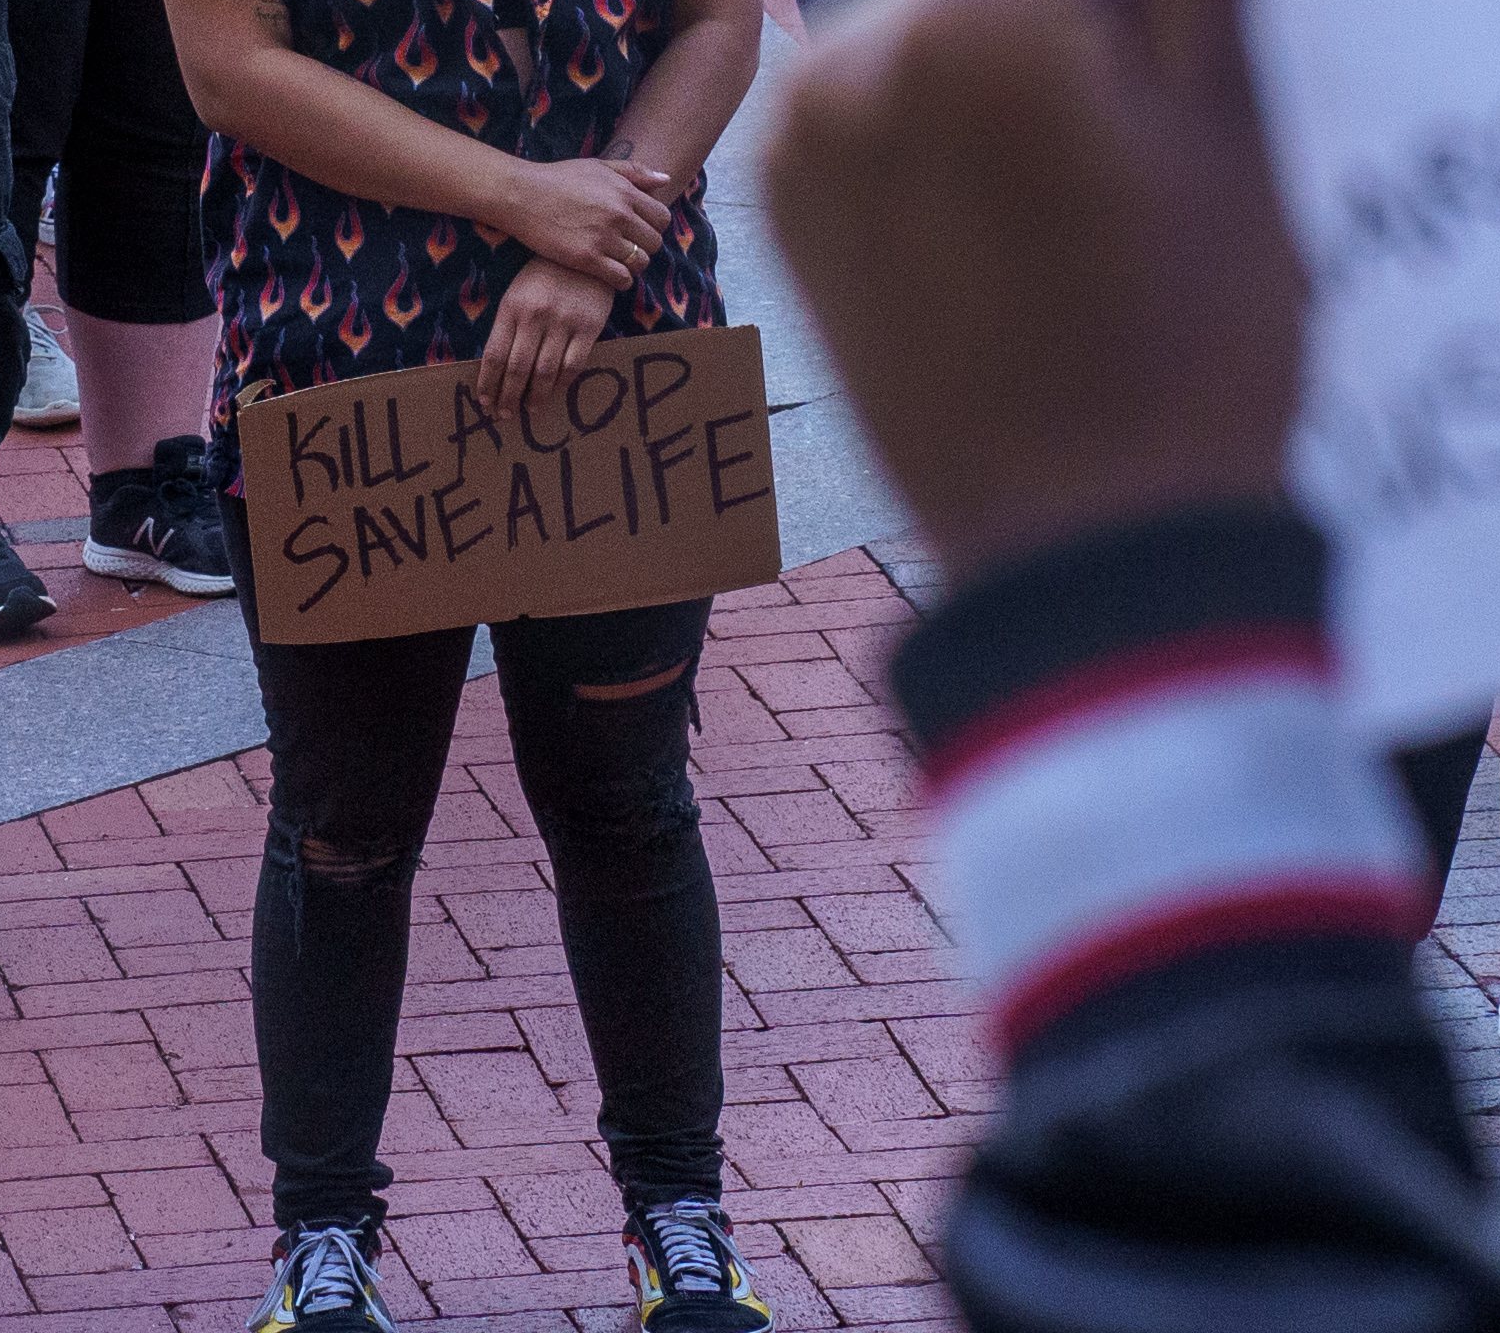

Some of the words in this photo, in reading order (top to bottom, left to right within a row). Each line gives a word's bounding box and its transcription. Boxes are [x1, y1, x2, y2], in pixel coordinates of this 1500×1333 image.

[283, 476, 498, 615] SAVE
[505, 461, 548, 552] A
[557, 410, 772, 542] LIFE
[285, 411, 431, 507] KILL
[447, 379, 508, 479] A
[518, 349, 695, 456] COP
